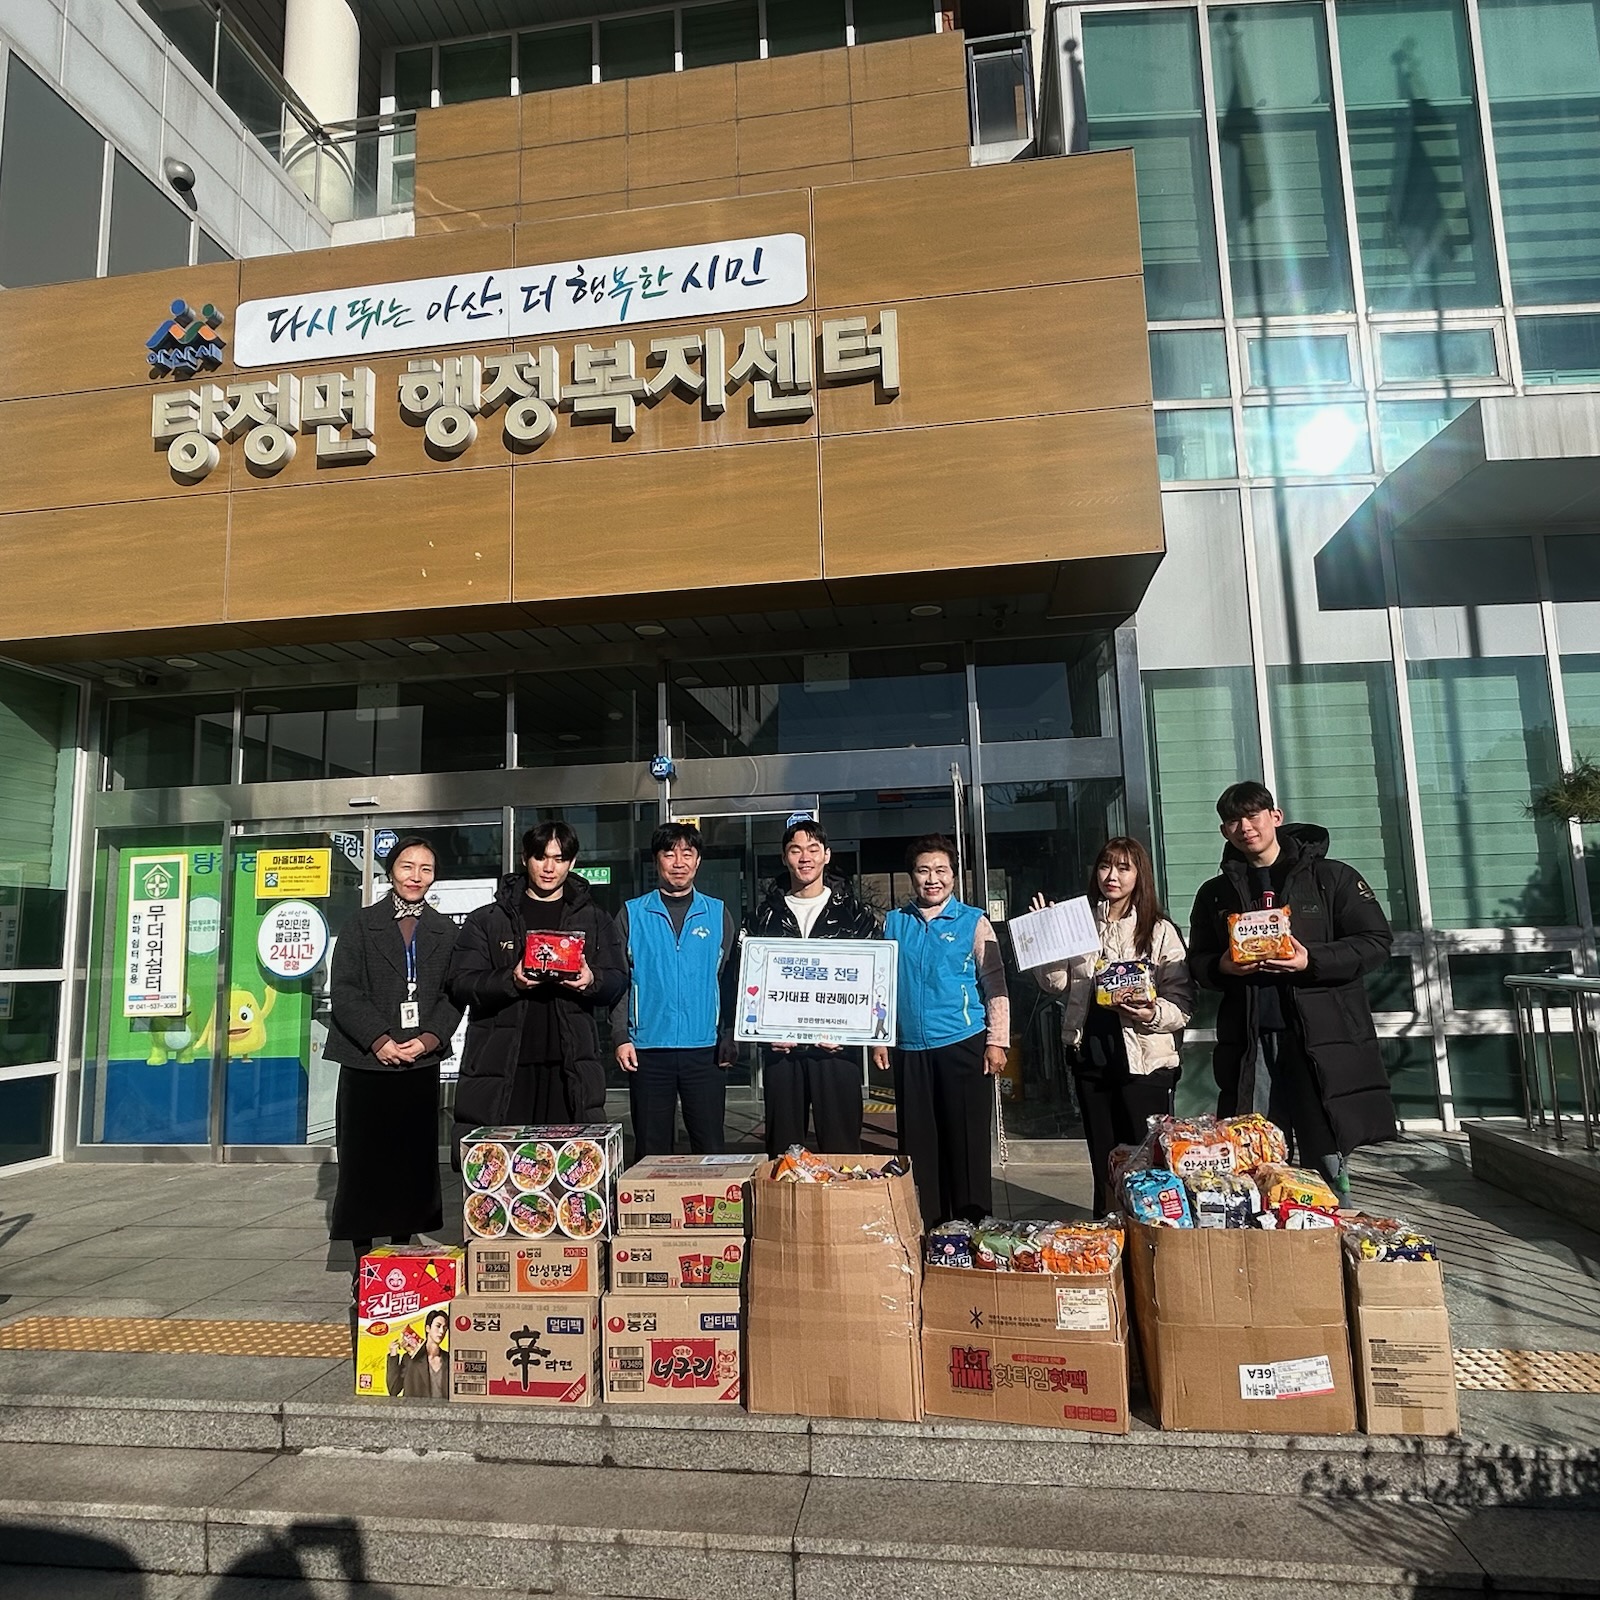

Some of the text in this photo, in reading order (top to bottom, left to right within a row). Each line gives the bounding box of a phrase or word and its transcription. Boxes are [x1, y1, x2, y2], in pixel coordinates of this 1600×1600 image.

[267, 305, 337, 343] 다시
[345, 297, 416, 340] 뛰는
[520, 274, 557, 313] 더
[566, 263, 673, 322] 행복한
[681, 247, 771, 293] 시민
[153, 309, 901, 480] 탕정면 행정복지센터
[377, 837, 396, 849] ADT
[272, 855, 315, 865] 마을대피소
[586, 869, 608, 877] AED
[276, 918, 311, 931] 무인민원
[1238, 923, 1280, 936] 안성탕면
[275, 931, 311, 943] 발급창구
[145, 905, 166, 992] 무더위쉼터
[270, 943, 315, 960] 24시간
[283, 960, 300, 971] 운영
[780, 965, 859, 982] 후원물품 전달
[767, 990, 870, 1006] 국가대표 태권메이커
[1183, 1156, 1231, 1172] 안성탕면
[633, 1192, 655, 1203] 농심
[528, 1263, 573, 1277] 안성탕면
[366, 1291, 421, 1320] 진라면
[472, 1318, 501, 1332] 농심
[549, 1318, 581, 1332] 멀티팩
[627, 1318, 657, 1332] 농심
[703, 1314, 737, 1329] 멀티팩
[505, 1324, 552, 1391] 辛
[952, 1346, 990, 1369] HOT
[544, 1358, 573, 1372] 라면
[653, 1357, 713, 1380] 너구리
[950, 1366, 993, 1390] TIME
[993, 1362, 1088, 1395] 핫타임핫팩
[1247, 1368, 1272, 1379] GEA
